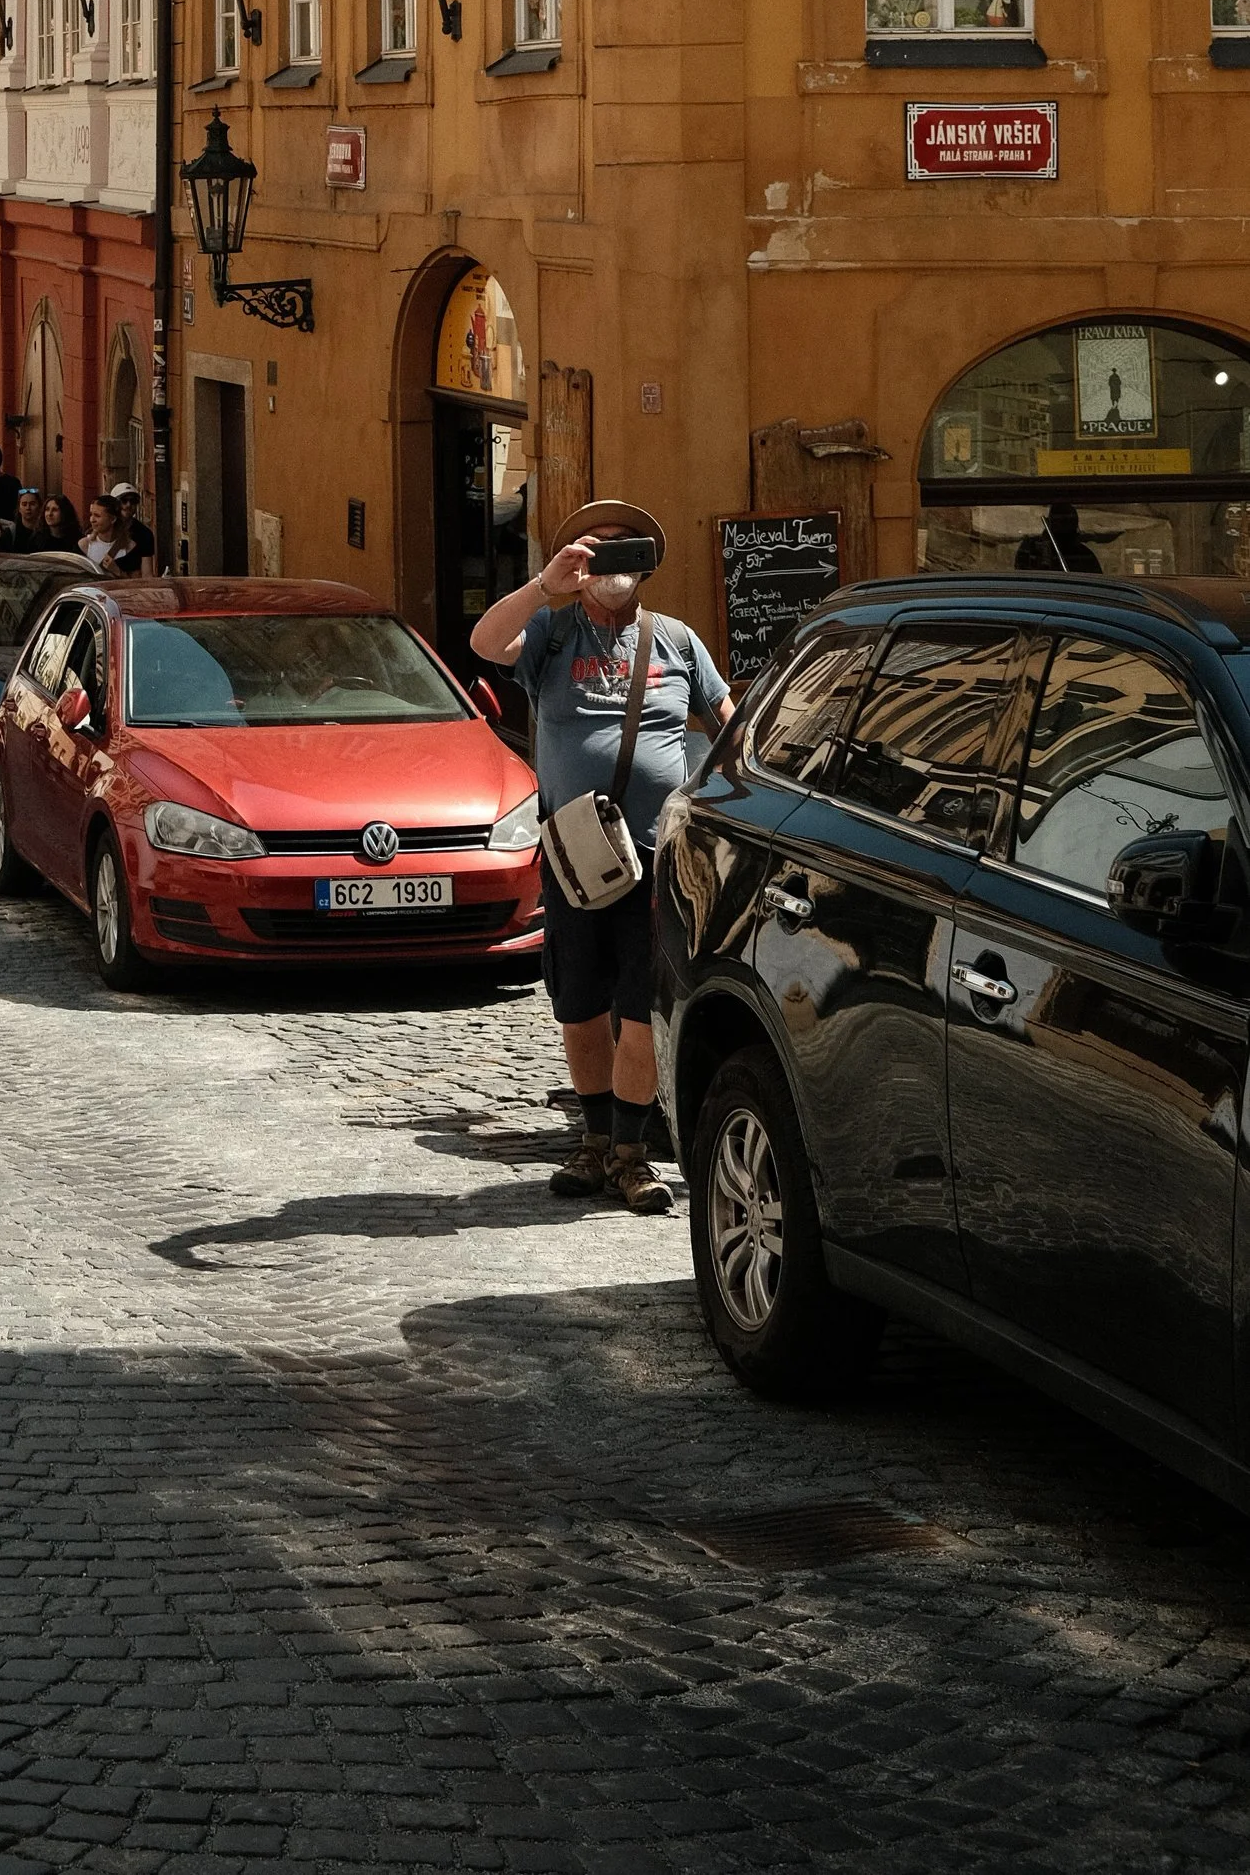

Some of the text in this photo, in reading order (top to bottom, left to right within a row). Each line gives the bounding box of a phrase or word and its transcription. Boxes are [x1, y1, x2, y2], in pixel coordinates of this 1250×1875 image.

[926, 119, 1041, 145] JÁNSKÝ VRŠEK
[939, 148, 961, 162] MALÁ
[963, 150, 993, 161] STRANA
[998, 151, 1025, 161] PRAHA
[1026, 151, 1031, 161] 1
[1078, 325, 1146, 339] FRANZ KAFKA
[1088, 421, 1146, 432] PRAGUE
[725, 562, 743, 591] Beer
[730, 589, 782, 609] Beer Snacks
[734, 605, 760, 618] CZECH
[761, 600, 802, 614] Traditional
[734, 629, 753, 643] Open
[335, 882, 373, 905] 6C2
[392, 880, 442, 904] 1930
